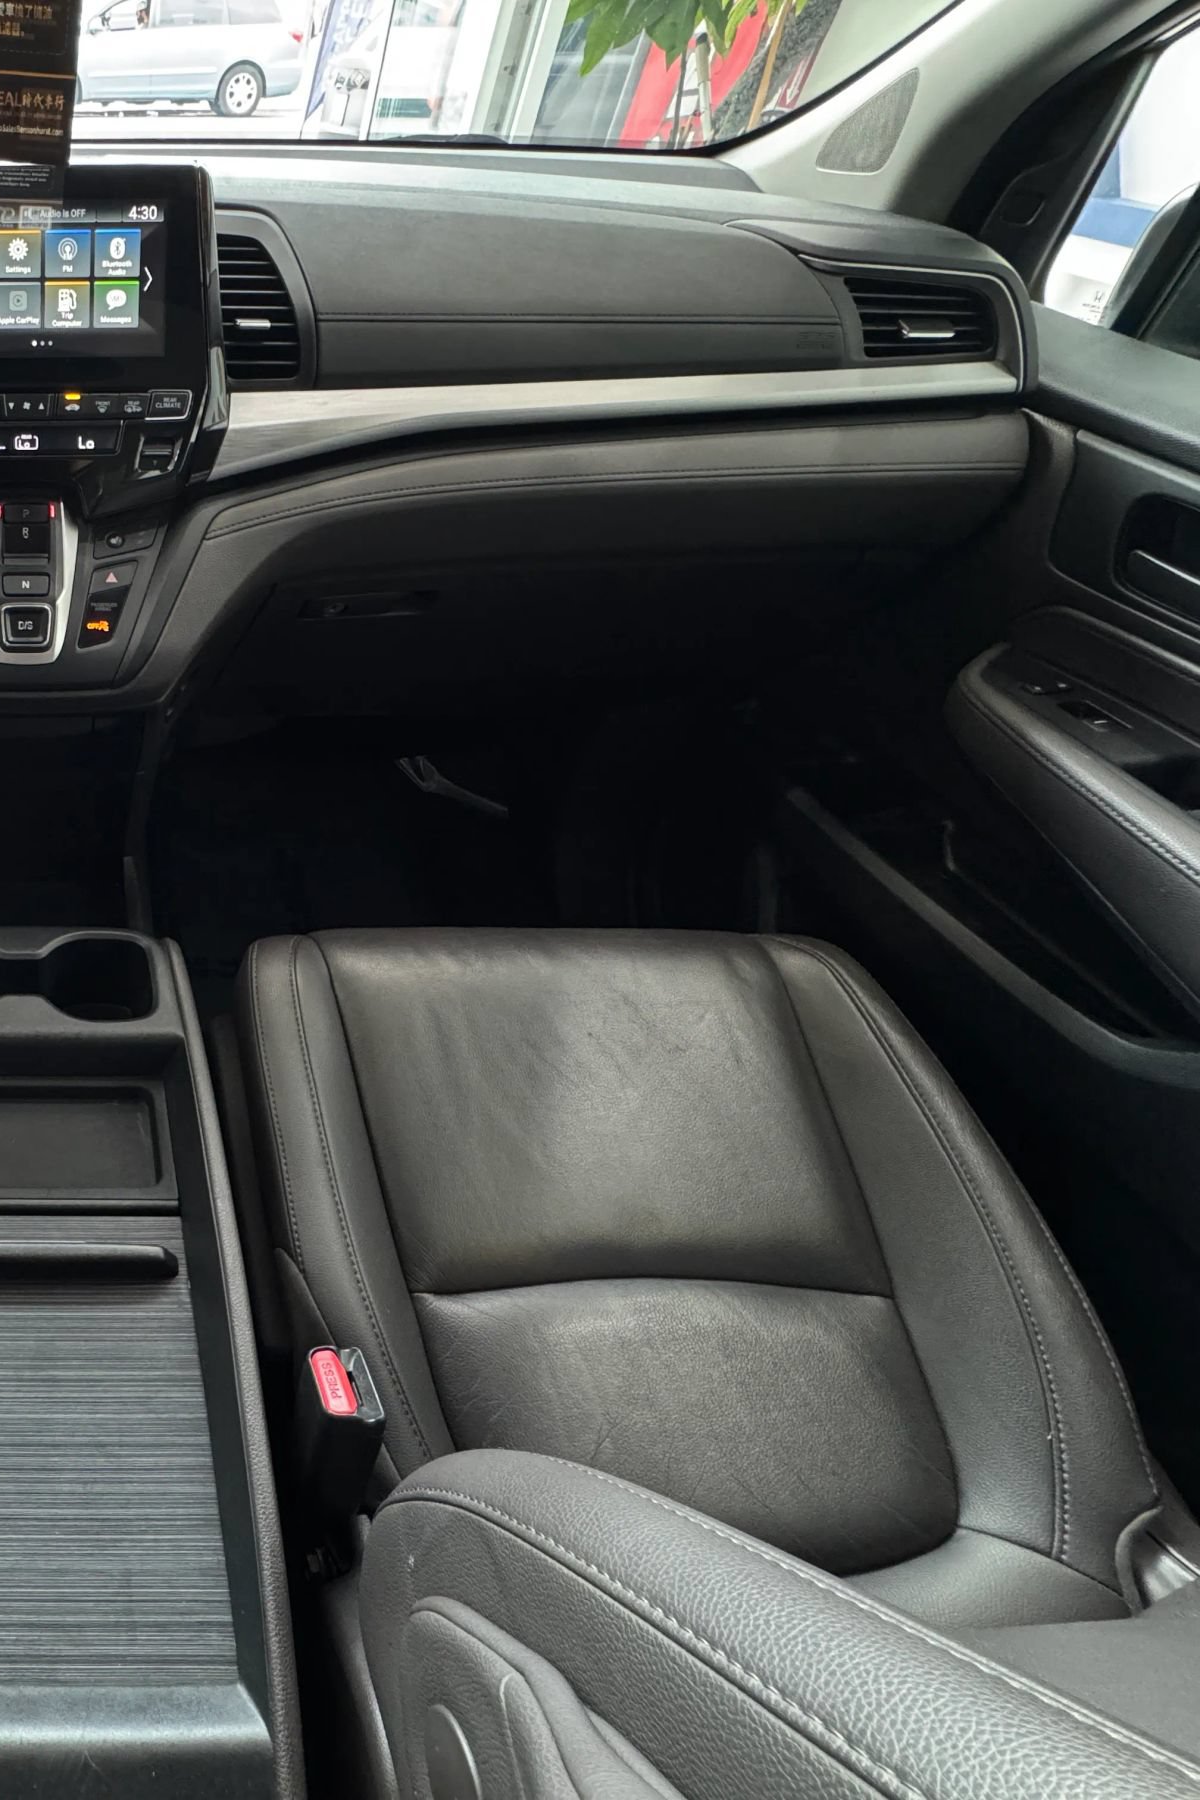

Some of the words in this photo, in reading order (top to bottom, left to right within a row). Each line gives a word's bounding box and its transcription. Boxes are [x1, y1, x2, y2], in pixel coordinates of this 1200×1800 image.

[40, 208, 61, 218] Audio
[71, 208, 86, 218] OFF
[129, 205, 158, 220] 4:30
[102, 260, 133, 268] Bluetooth
[5, 266, 32, 275] Settings
[62, 265, 73, 273] FM
[107, 268, 127, 276] Audio
[61, 311, 74, 320] Trip
[100, 316, 132, 324] Messages
[16, 316, 40, 326] CarPlay
[52, 319, 82, 328] Computer
[78, 435, 95, 449] Lo
[23, 509, 30, 518] P
[21, 580, 30, 589] N
[18, 620, 34, 630] D/S
[321, 1362, 343, 1400] PRESS
